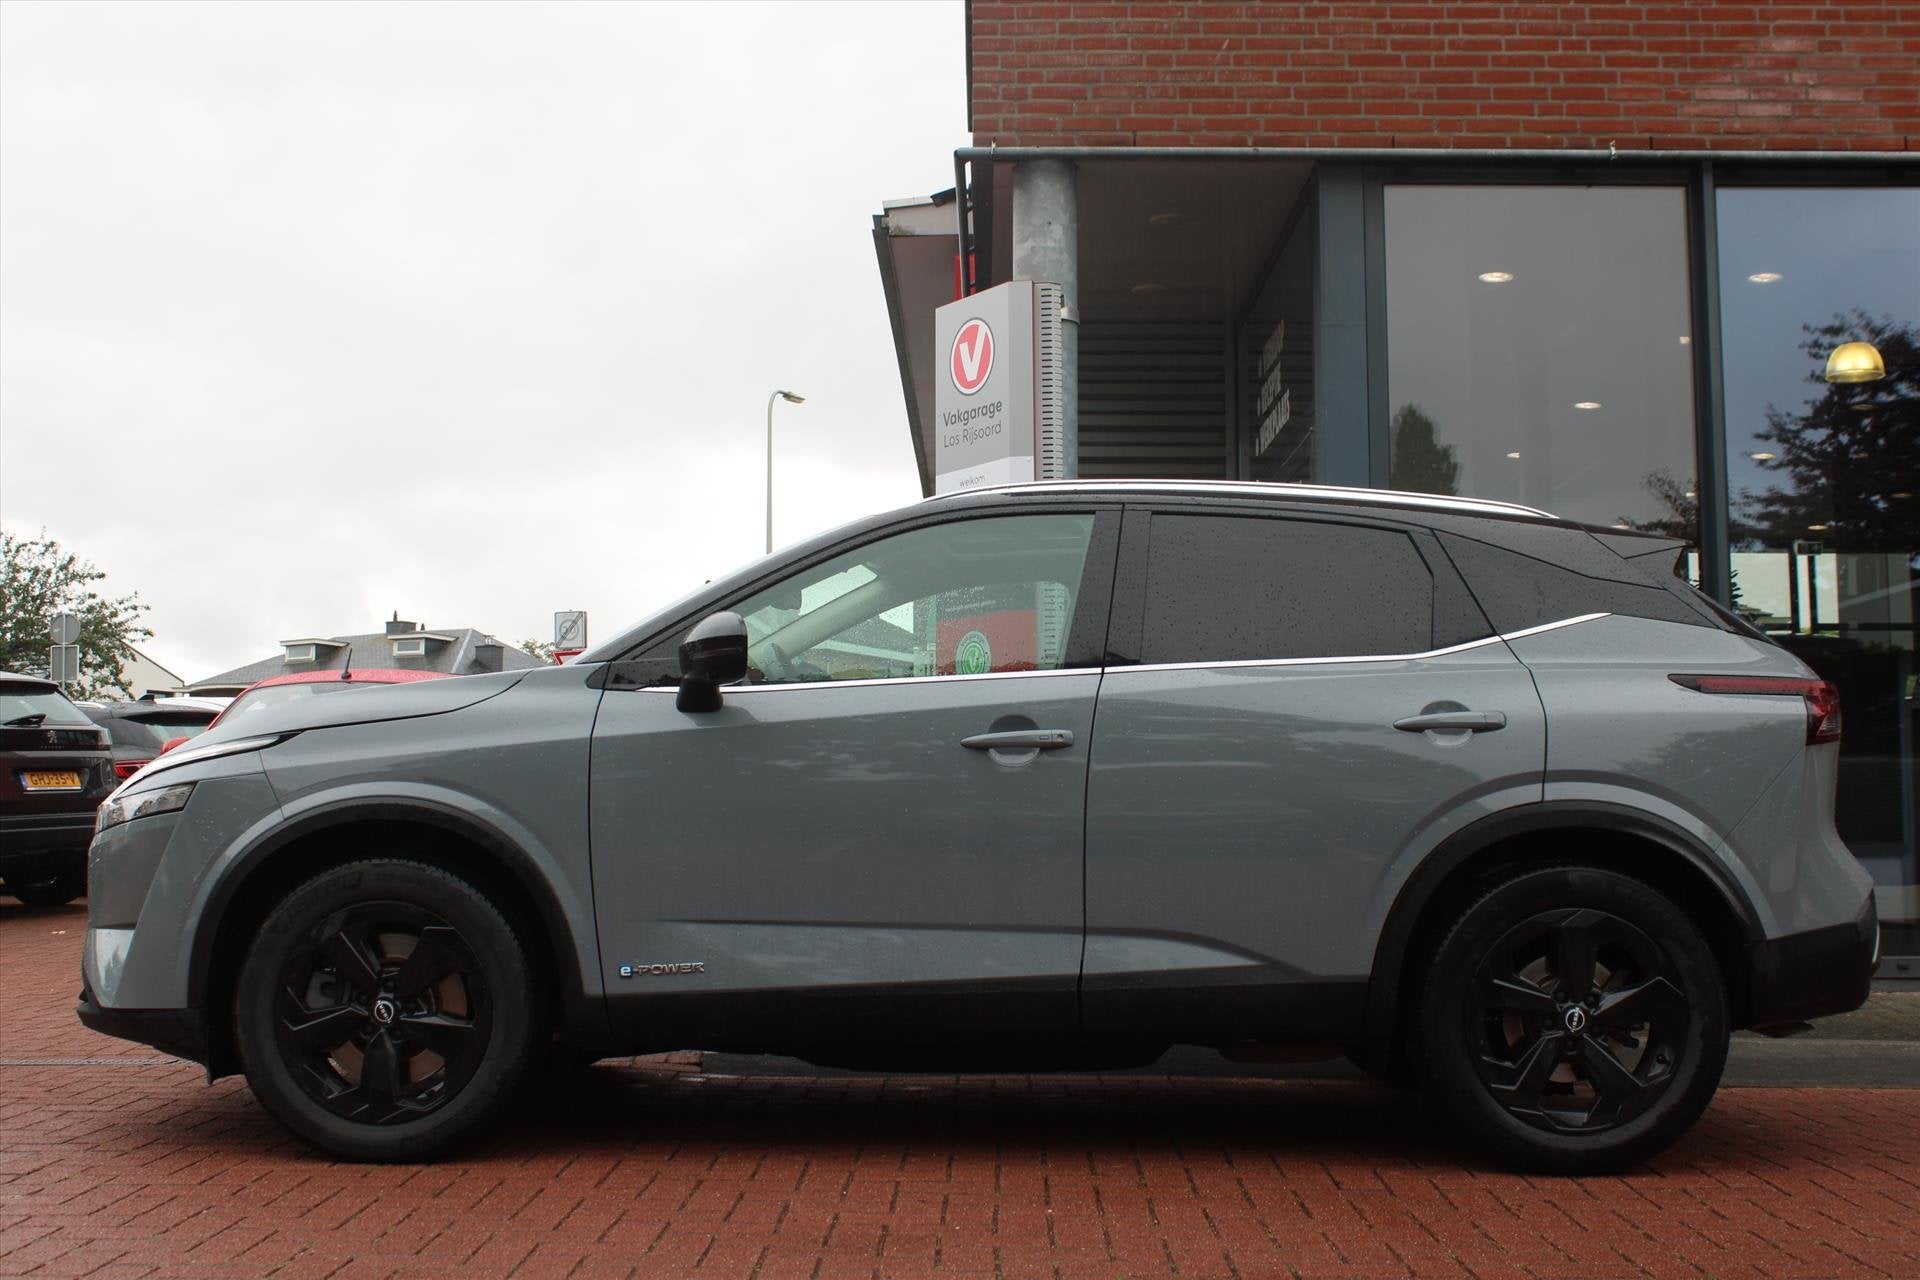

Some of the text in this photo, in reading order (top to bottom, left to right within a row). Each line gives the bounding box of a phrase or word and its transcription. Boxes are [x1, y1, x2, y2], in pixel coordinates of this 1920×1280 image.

[943, 400, 1002, 426] Vakgarage
[943, 420, 1002, 448] Los Rijsoord
[959, 474, 986, 488] welkom
[620, 962, 705, 977] e-POWER
